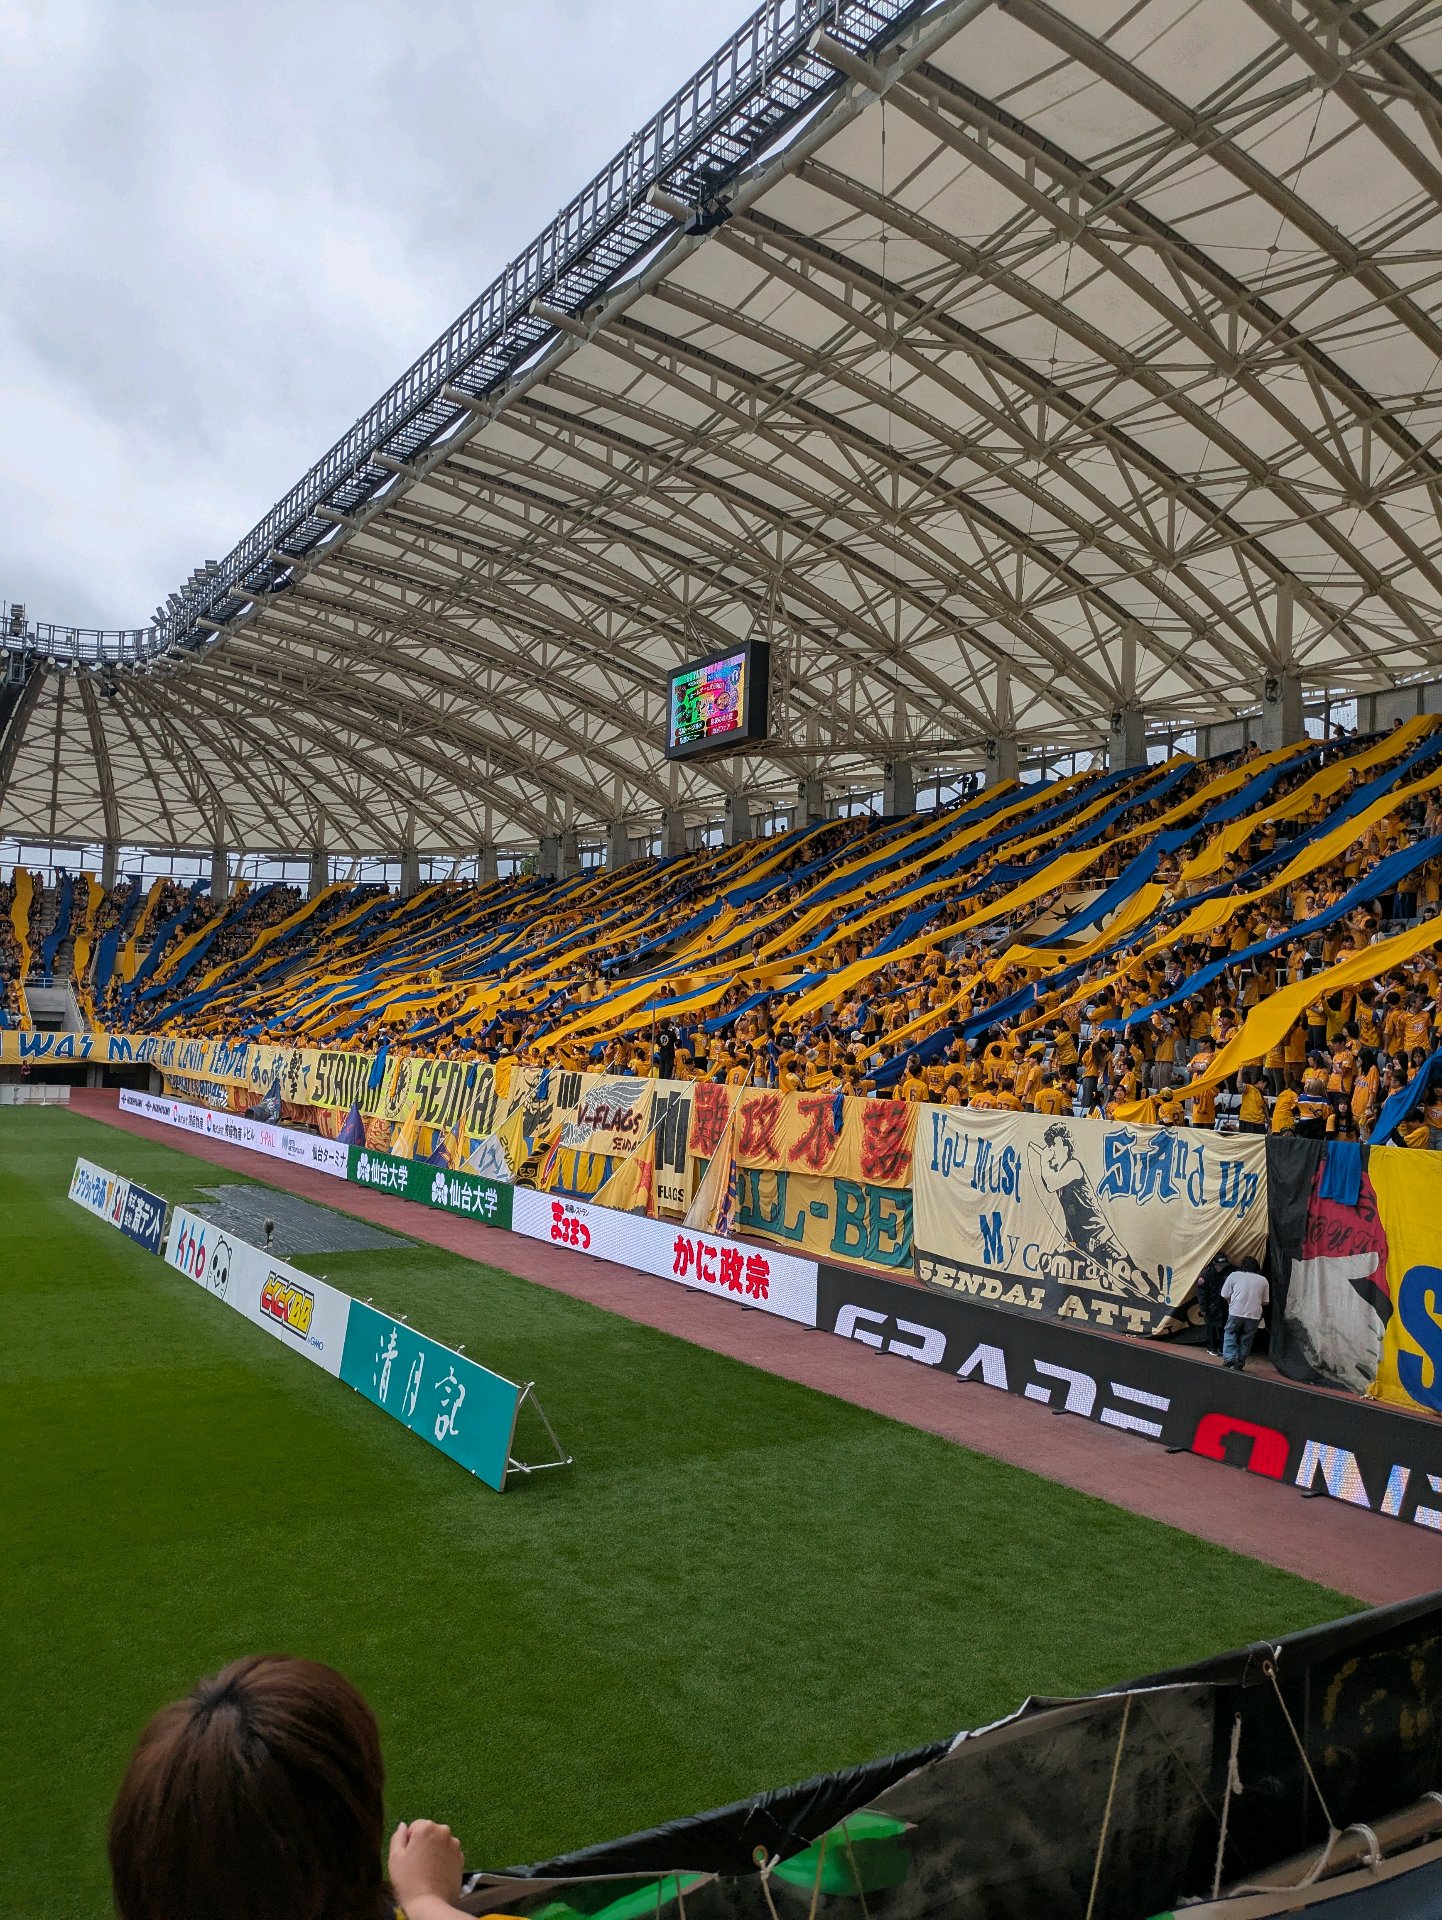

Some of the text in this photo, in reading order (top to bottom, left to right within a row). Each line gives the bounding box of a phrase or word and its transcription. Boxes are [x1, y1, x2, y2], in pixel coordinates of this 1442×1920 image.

[19, 1032, 95, 1059] WAS
[577, 1101, 643, 1136] V-FLAGS
[311, 1143, 348, 1169] 仙台ターミナ
[931, 1112, 966, 1178] You
[371, 1159, 408, 1193] 仙台大学
[449, 1181, 498, 1219] 仙台大学
[657, 1184, 685, 1203] FLAGS
[1218, 1159, 1259, 1219] Up
[174, 1218, 206, 1279] khb
[550, 1199, 592, 1250] まるまつ
[978, 1210, 1018, 1272] My
[672, 1234, 771, 1300] かに政宗
[918, 1259, 1047, 1311] SENDAI
[310, 1336, 324, 1351] GMO
[373, 1326, 466, 1441] 清月記
